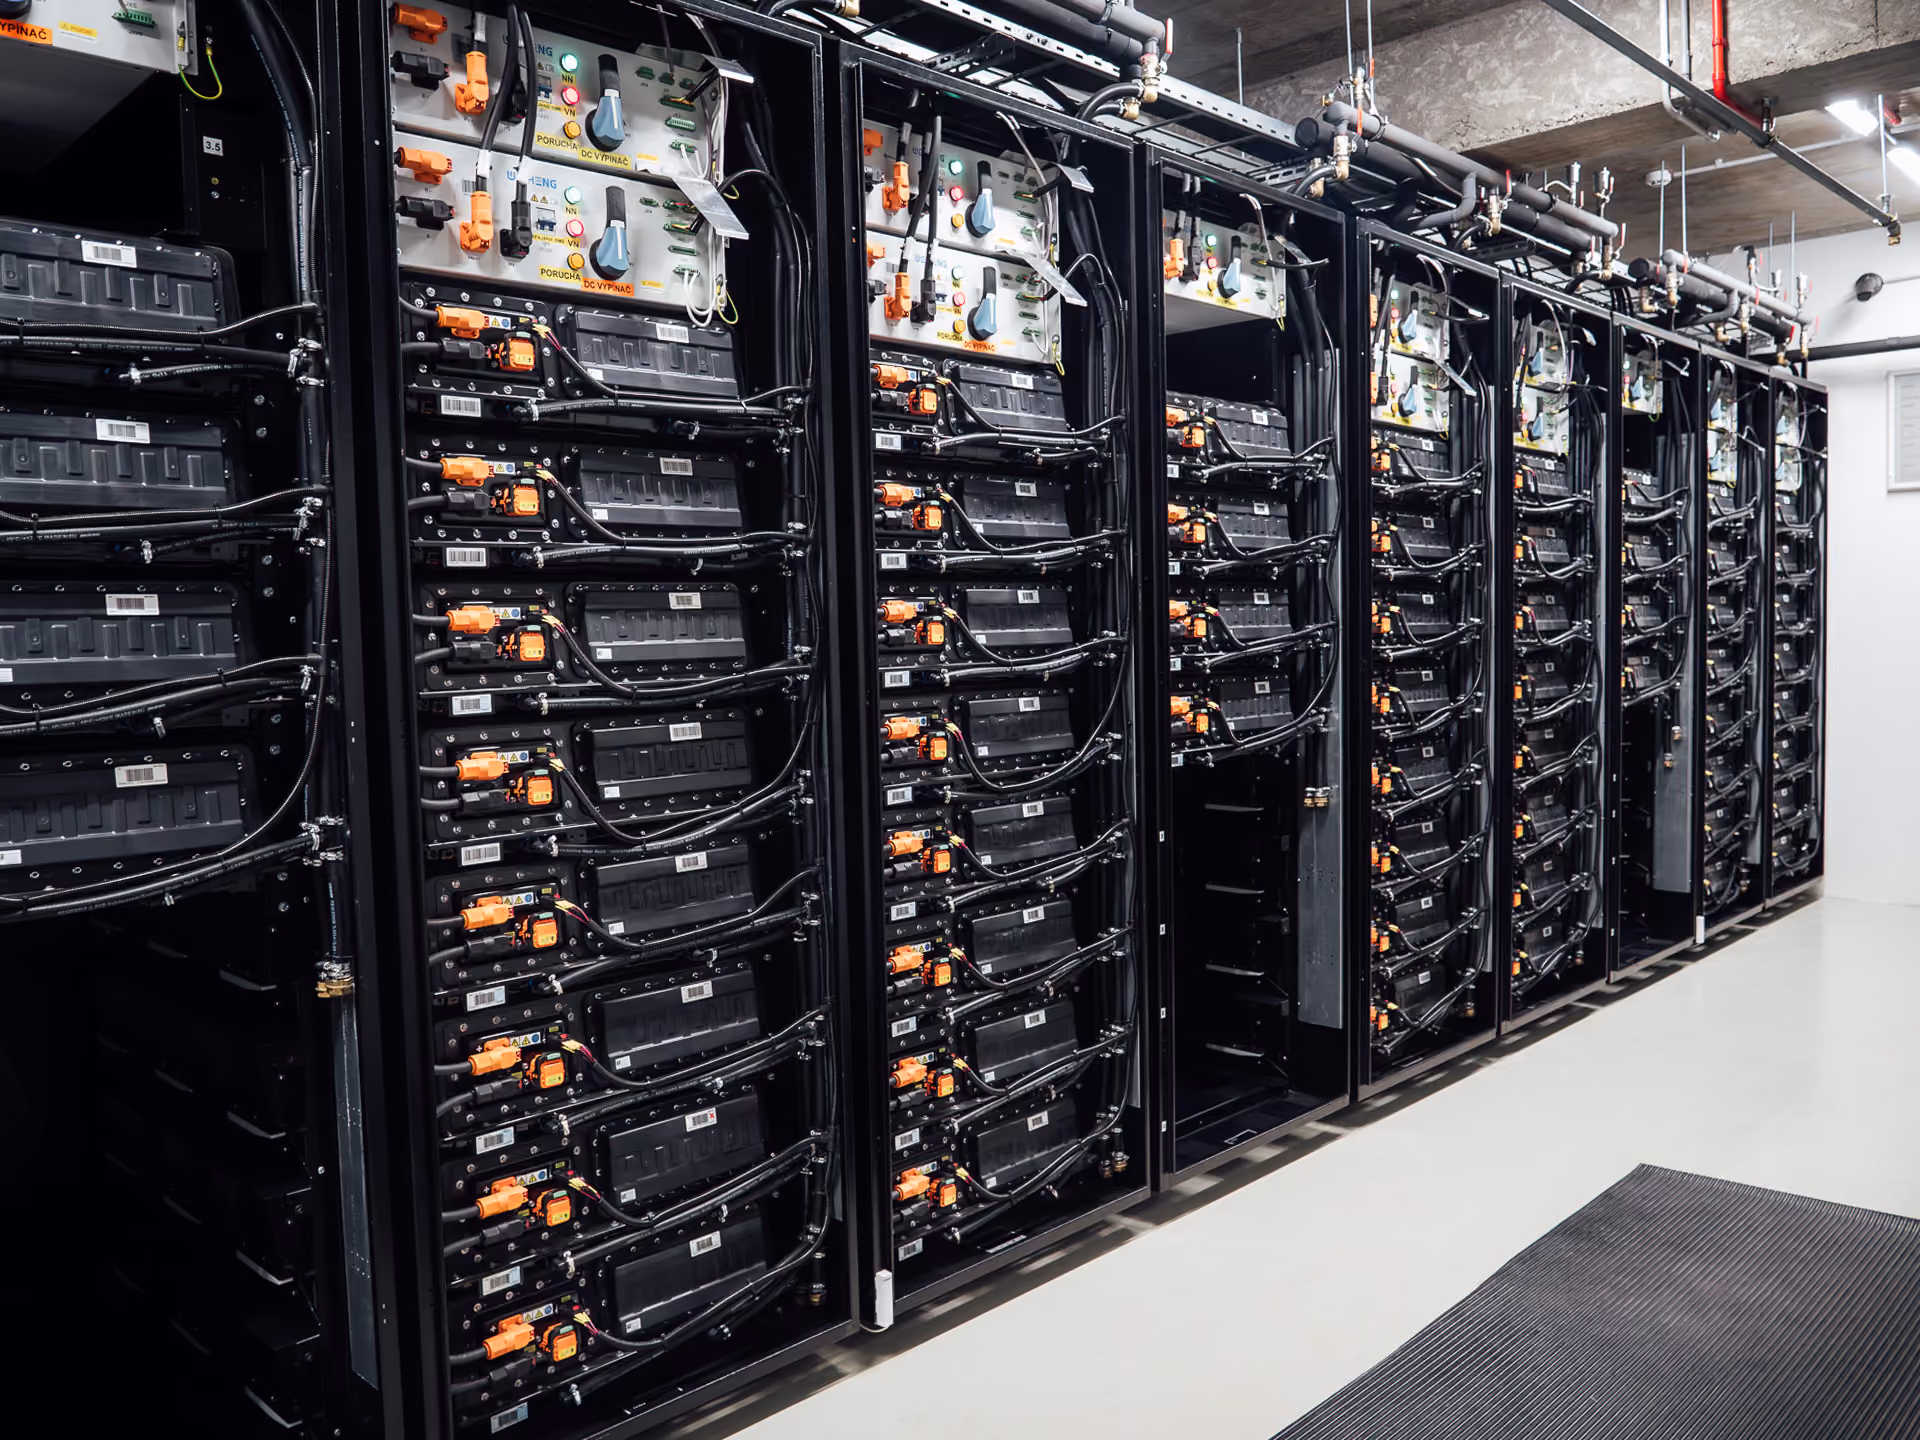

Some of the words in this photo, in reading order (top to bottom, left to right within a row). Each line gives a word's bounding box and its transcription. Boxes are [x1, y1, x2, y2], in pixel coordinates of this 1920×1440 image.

[0, 21, 47, 40] YPÍNAČ
[562, 74, 573, 83] NN
[564, 107, 576, 117] VN
[205, 140, 221, 152] 3.5
[537, 134, 578, 150] PORUCHA
[581, 149, 592, 159] DC
[565, 206, 577, 215] NN
[567, 239, 579, 248] VN
[540, 267, 581, 281] PORUCHA
[584, 280, 596, 289] DC
